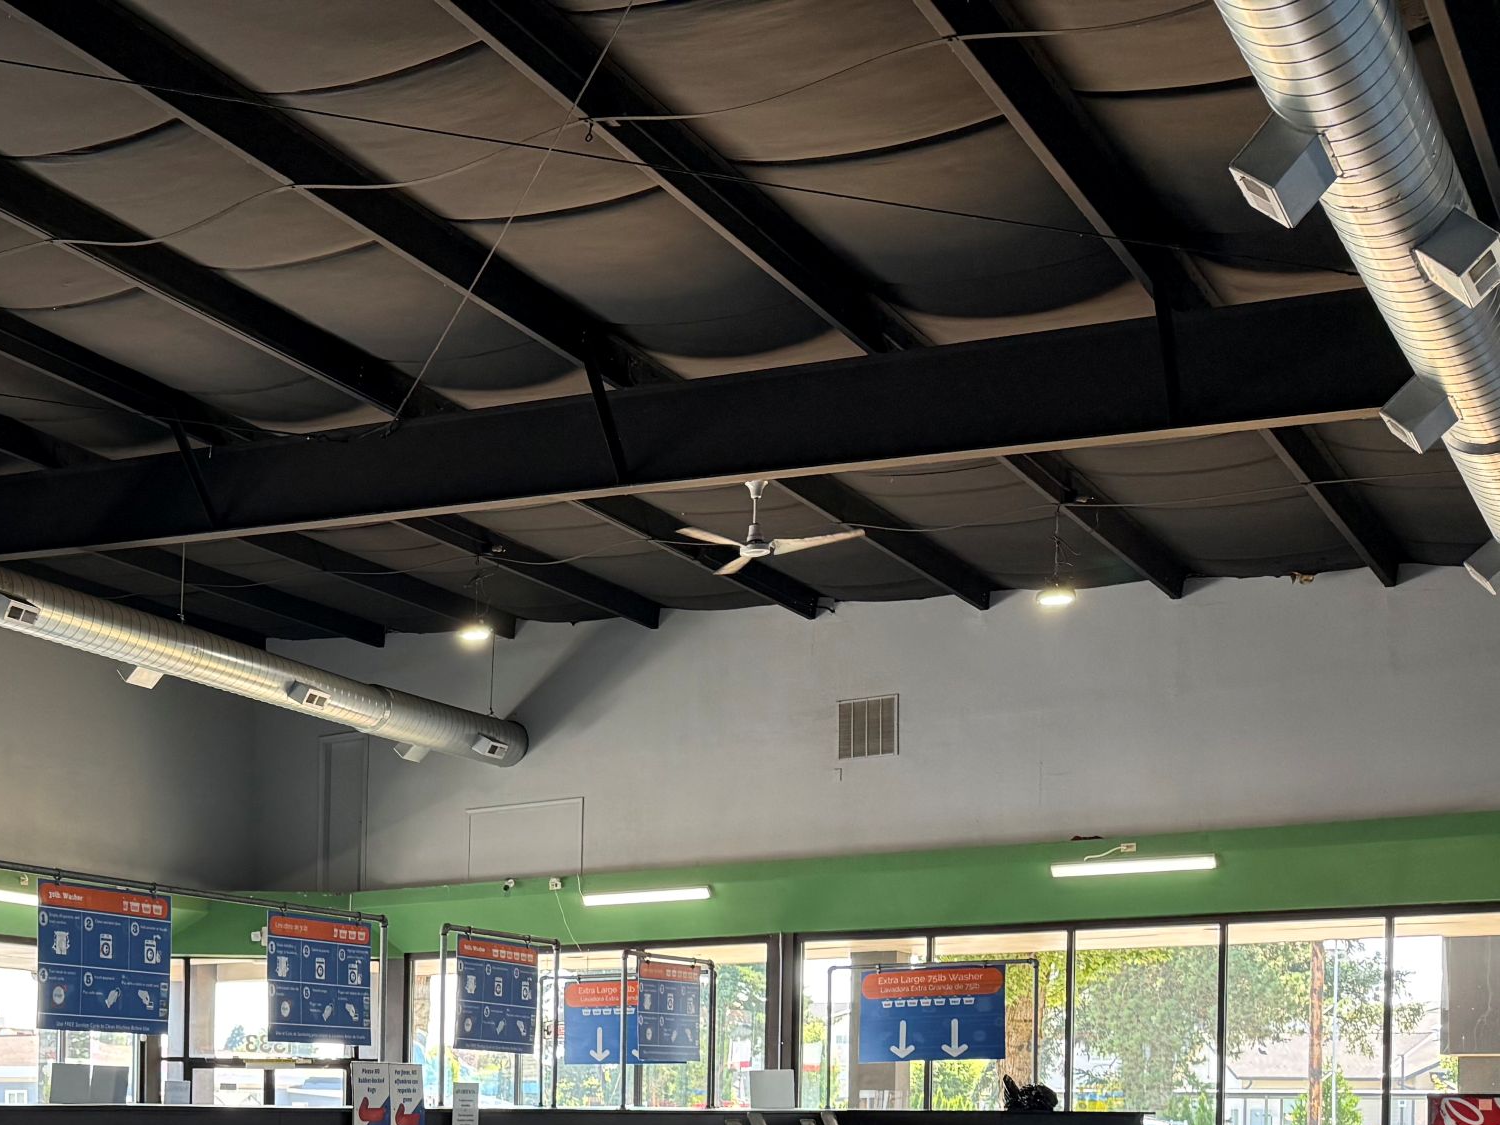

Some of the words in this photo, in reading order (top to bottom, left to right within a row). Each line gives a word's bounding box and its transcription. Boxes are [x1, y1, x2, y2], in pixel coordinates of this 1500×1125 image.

[63, 892, 84, 902] Washer
[878, 977, 899, 985] Extra
[900, 976, 926, 985] Large
[927, 974, 946, 984] 75lb
[948, 972, 984, 982] Washer
[578, 986, 595, 994] Extra
[597, 986, 618, 996] Large
[880, 986, 910, 994] Lavadora
[928, 983, 953, 991] Grande
